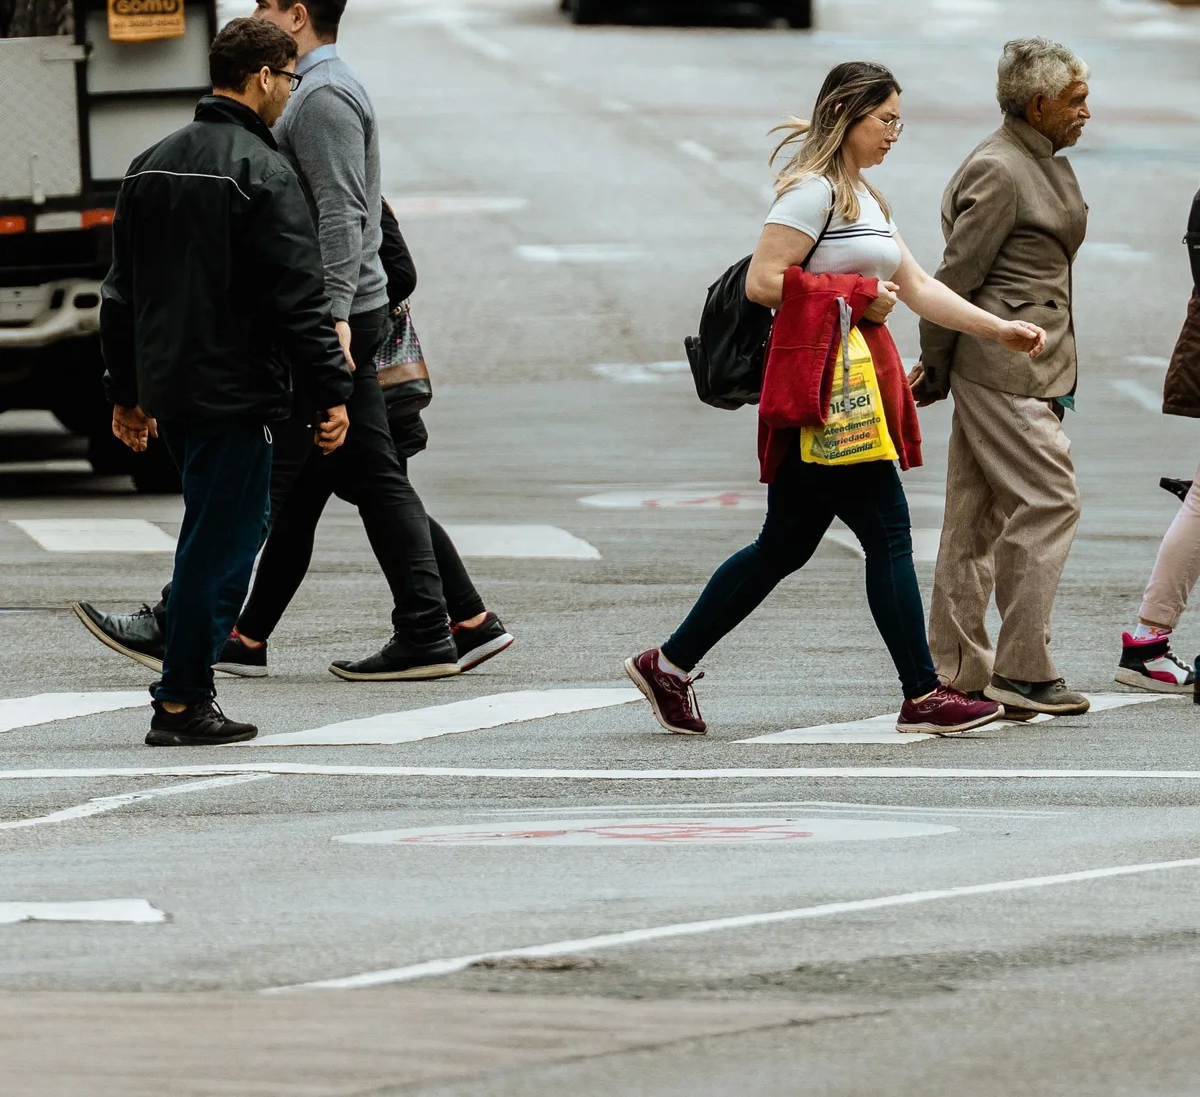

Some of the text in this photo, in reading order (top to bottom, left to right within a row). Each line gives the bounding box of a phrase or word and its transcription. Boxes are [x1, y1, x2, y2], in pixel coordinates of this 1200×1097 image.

[824, 416, 881, 435] Atendimento
[826, 431, 871, 448] Variedade
[829, 442, 873, 460] Economia
